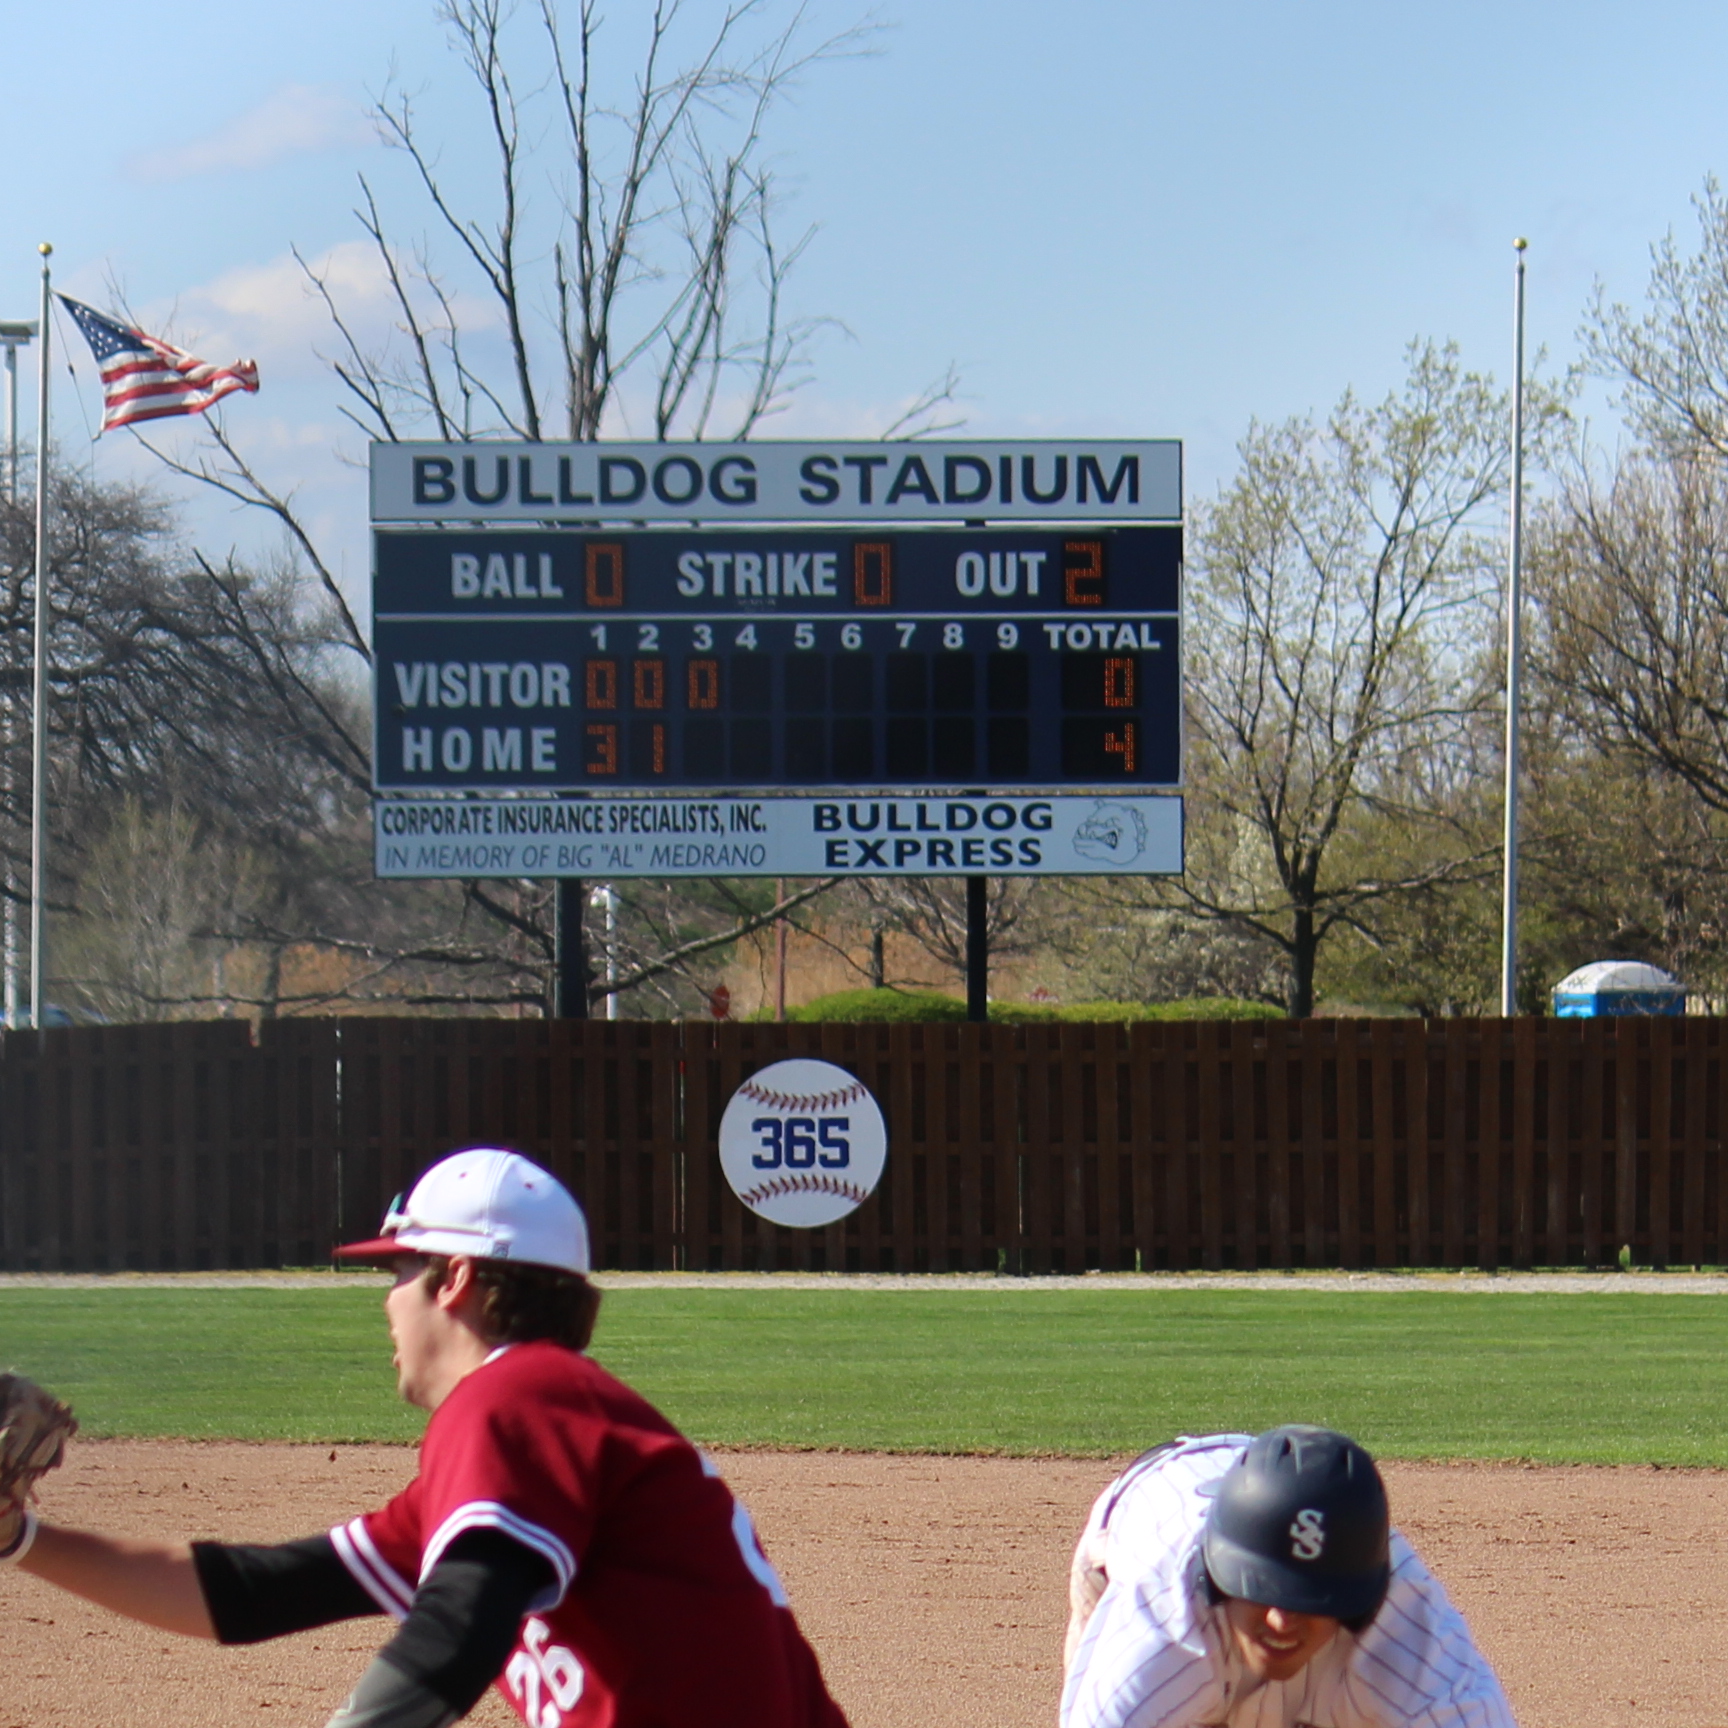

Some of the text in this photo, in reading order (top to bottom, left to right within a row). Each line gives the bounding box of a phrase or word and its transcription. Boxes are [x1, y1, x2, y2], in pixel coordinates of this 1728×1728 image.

[412, 455, 1140, 505] BULLDOG STADIUM
[451, 541, 1102, 607] BALL 0 STRIKE 0 OUT 2
[590, 622, 1161, 651] 1 2 3 4 5 6 7 8 9 TOTAL
[393, 657, 1135, 709] VISITOR 0 0 0 0
[402, 722, 1135, 774] HOME 3 1 4
[381, 804, 768, 837] CORPORATE INSURANCE SPECIALISTS, INC.
[812, 803, 1052, 832] BULLDOG
[384, 843, 766, 869] IN MEMORY OF BIG "AL" MEDRANO
[824, 838, 1043, 868] EXPRESS
[751, 1117, 850, 1169] 365
